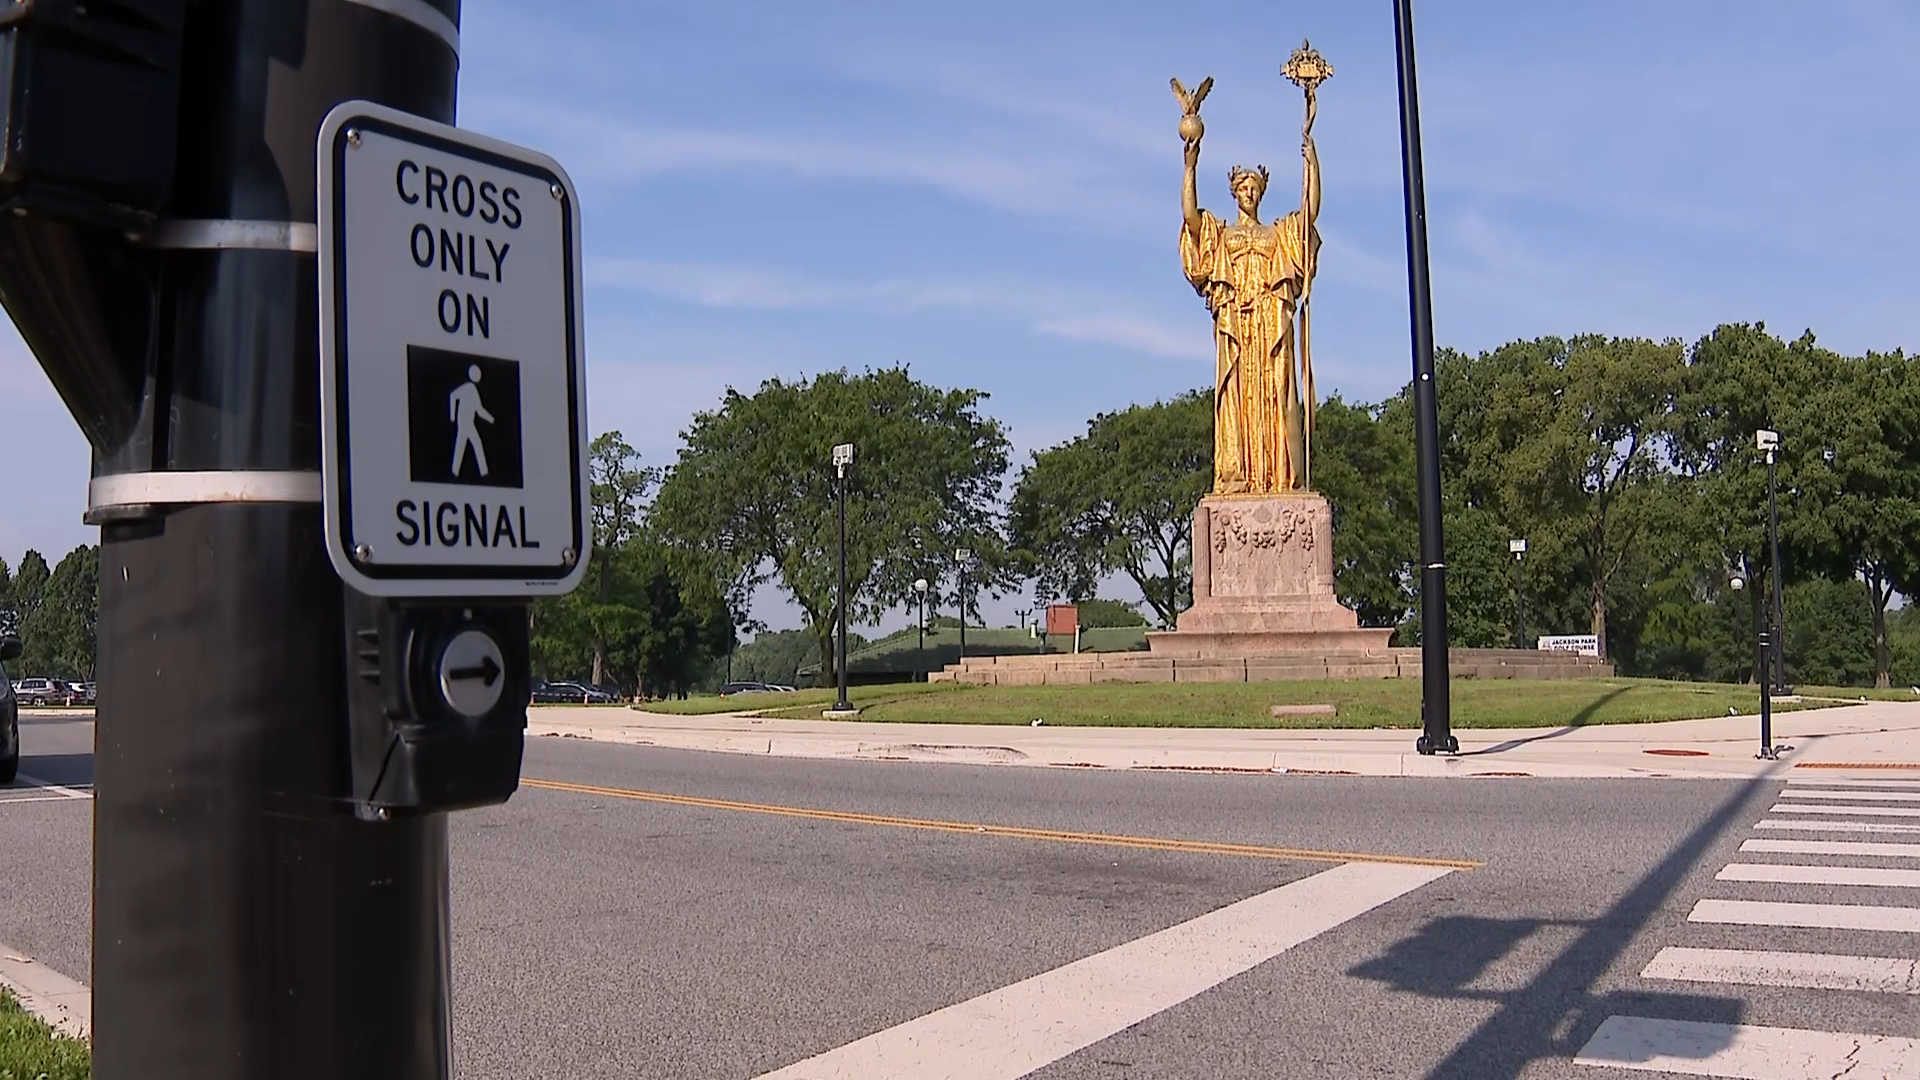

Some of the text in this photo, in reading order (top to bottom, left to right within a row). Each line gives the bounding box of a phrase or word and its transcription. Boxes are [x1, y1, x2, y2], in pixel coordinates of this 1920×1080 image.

[396, 159, 523, 229] CROSS
[410, 223, 510, 283] ONLY
[437, 288, 490, 339] ON
[395, 499, 540, 549] SIGNAL
